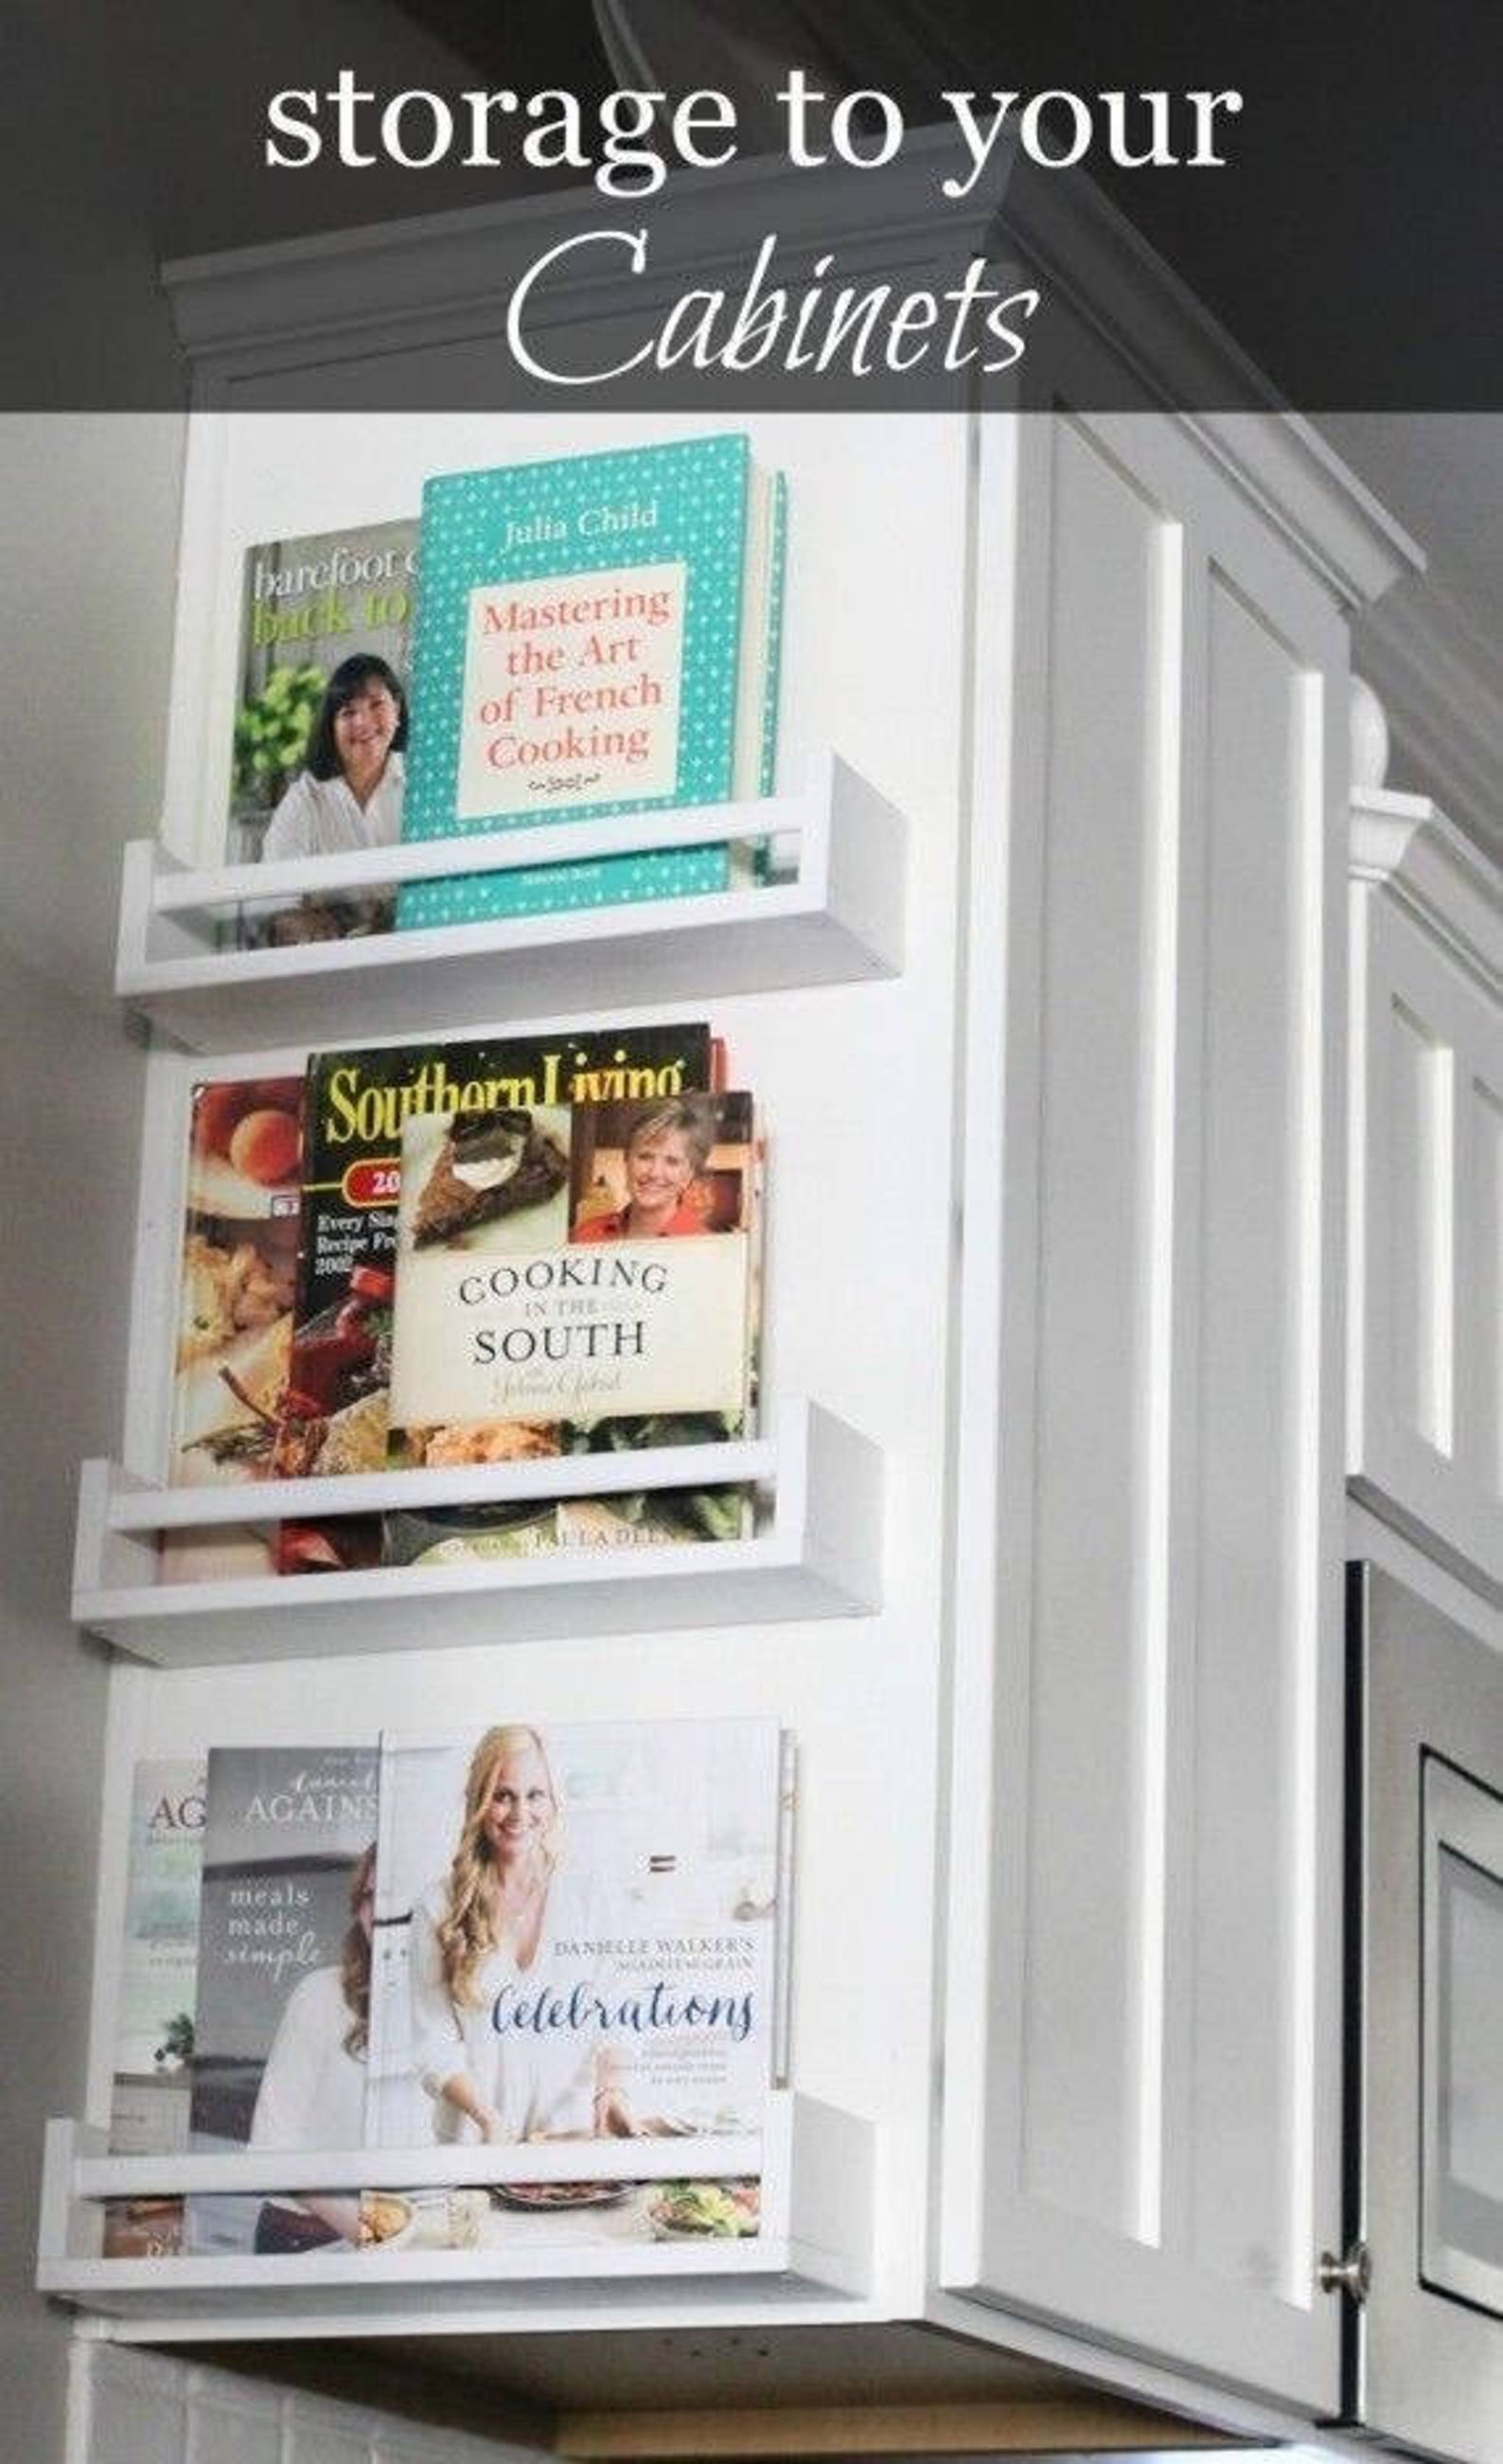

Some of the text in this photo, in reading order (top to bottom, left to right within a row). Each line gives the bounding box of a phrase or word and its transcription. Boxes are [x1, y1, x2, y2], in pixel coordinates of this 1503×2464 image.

[499, 500, 660, 555] Julia Child
[254, 546, 398, 599] barefoot
[253, 589, 409, 647] back to
[483, 588, 675, 635] Mastering
[507, 634, 642, 677] the Art
[480, 673, 663, 724] of French
[486, 724, 650, 771] Cooking
[326, 1059, 535, 1143] Southern
[316, 1233, 369, 1256] Recipe
[317, 1214, 364, 1232] Every
[459, 1258, 668, 1304] COOKING
[525, 1298, 599, 1317] IN THE
[474, 1321, 645, 1364] SOUTH
[230, 1885, 312, 1906] meals
[227, 1910, 300, 1936] made
[221, 1932, 320, 1983] simple
[554, 1941, 651, 1958] DANIELLE
[491, 1980, 755, 2042] Celebrations
